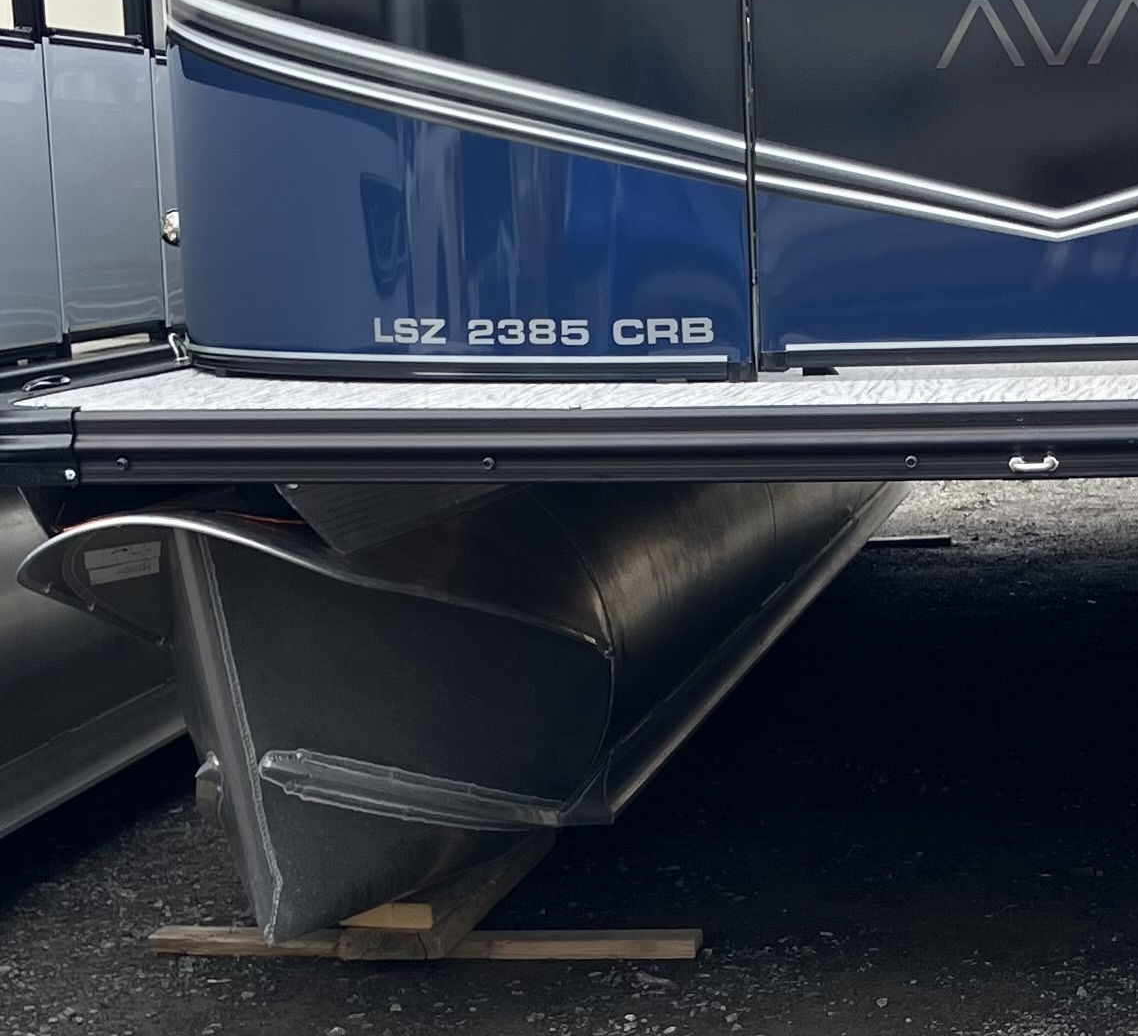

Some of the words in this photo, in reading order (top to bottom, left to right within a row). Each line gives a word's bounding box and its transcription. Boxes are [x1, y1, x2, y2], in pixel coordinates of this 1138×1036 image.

[373, 317, 447, 345] LSZ
[467, 318, 590, 346] 2385
[612, 317, 715, 346] CRB
